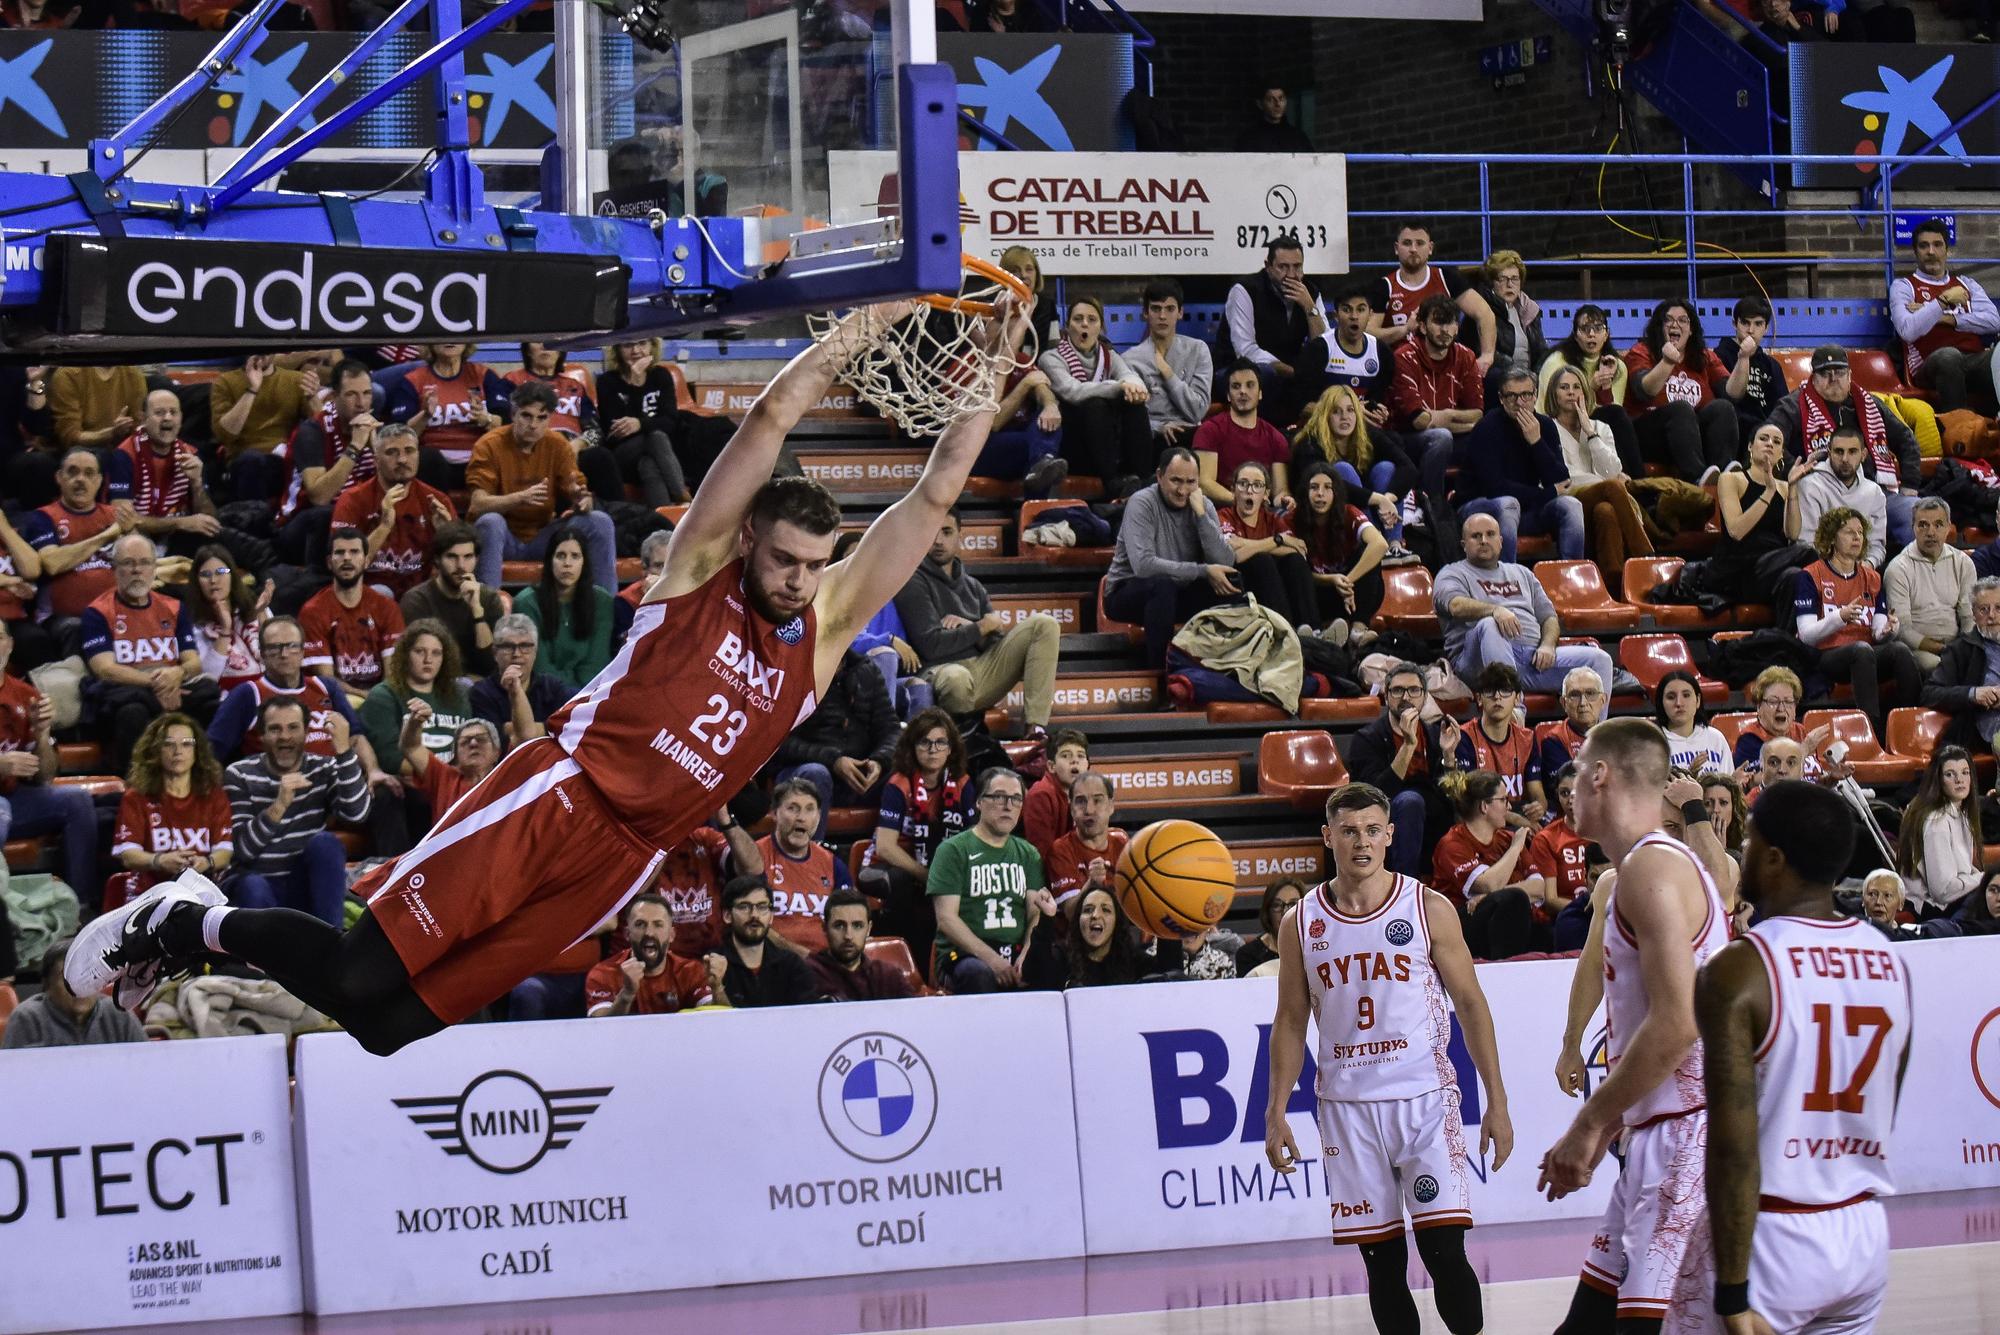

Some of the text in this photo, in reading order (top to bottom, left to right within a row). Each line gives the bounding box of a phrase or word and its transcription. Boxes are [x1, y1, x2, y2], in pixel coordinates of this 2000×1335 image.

[988, 178, 1210, 203] CATALANA
[990, 211, 1214, 236] DE TREBALL
[1063, 244, 1081, 257] de
[1085, 243, 1137, 258] Treball
[1141, 243, 1209, 259] Tempora
[127, 251, 486, 332] endesa
[868, 464, 924, 479] BAGES
[113, 637, 179, 664] BAXI
[713, 630, 785, 701] BAXI
[1093, 687, 1152, 705] BAGES
[688, 693, 748, 756] 23
[649, 727, 724, 792] MANRESA
[1172, 769, 1233, 786] BAGES
[151, 827, 211, 852] BAXI
[970, 862, 1027, 897] BOSTON
[1256, 857, 1317, 875] BAGES
[411, 891, 435, 925] Manresa
[772, 891, 829, 919] BAX
[983, 896, 1017, 930] 11
[1316, 952, 1411, 991] RYTAS
[1787, 946, 1899, 982] FOSTER
[1357, 995, 1375, 1031] 9
[832, 1039, 919, 1078] BMW
[1802, 1003, 1893, 1114] 17
[471, 1108, 541, 1139] MINI
[769, 1166, 1003, 1211] MOTOR MUNICH
[396, 1196, 628, 1234] MOTOR MUNICH
[856, 1211, 926, 1248] CADÍ
[129, 1265, 174, 1281] ADVANCED
[176, 1262, 203, 1277] SPORT
[214, 1257, 264, 1273] NUTRITIONS
[265, 1255, 281, 1268] LAB
[480, 1244, 552, 1277] CADÍ
[131, 1279, 203, 1299] LEAD THE WAY
